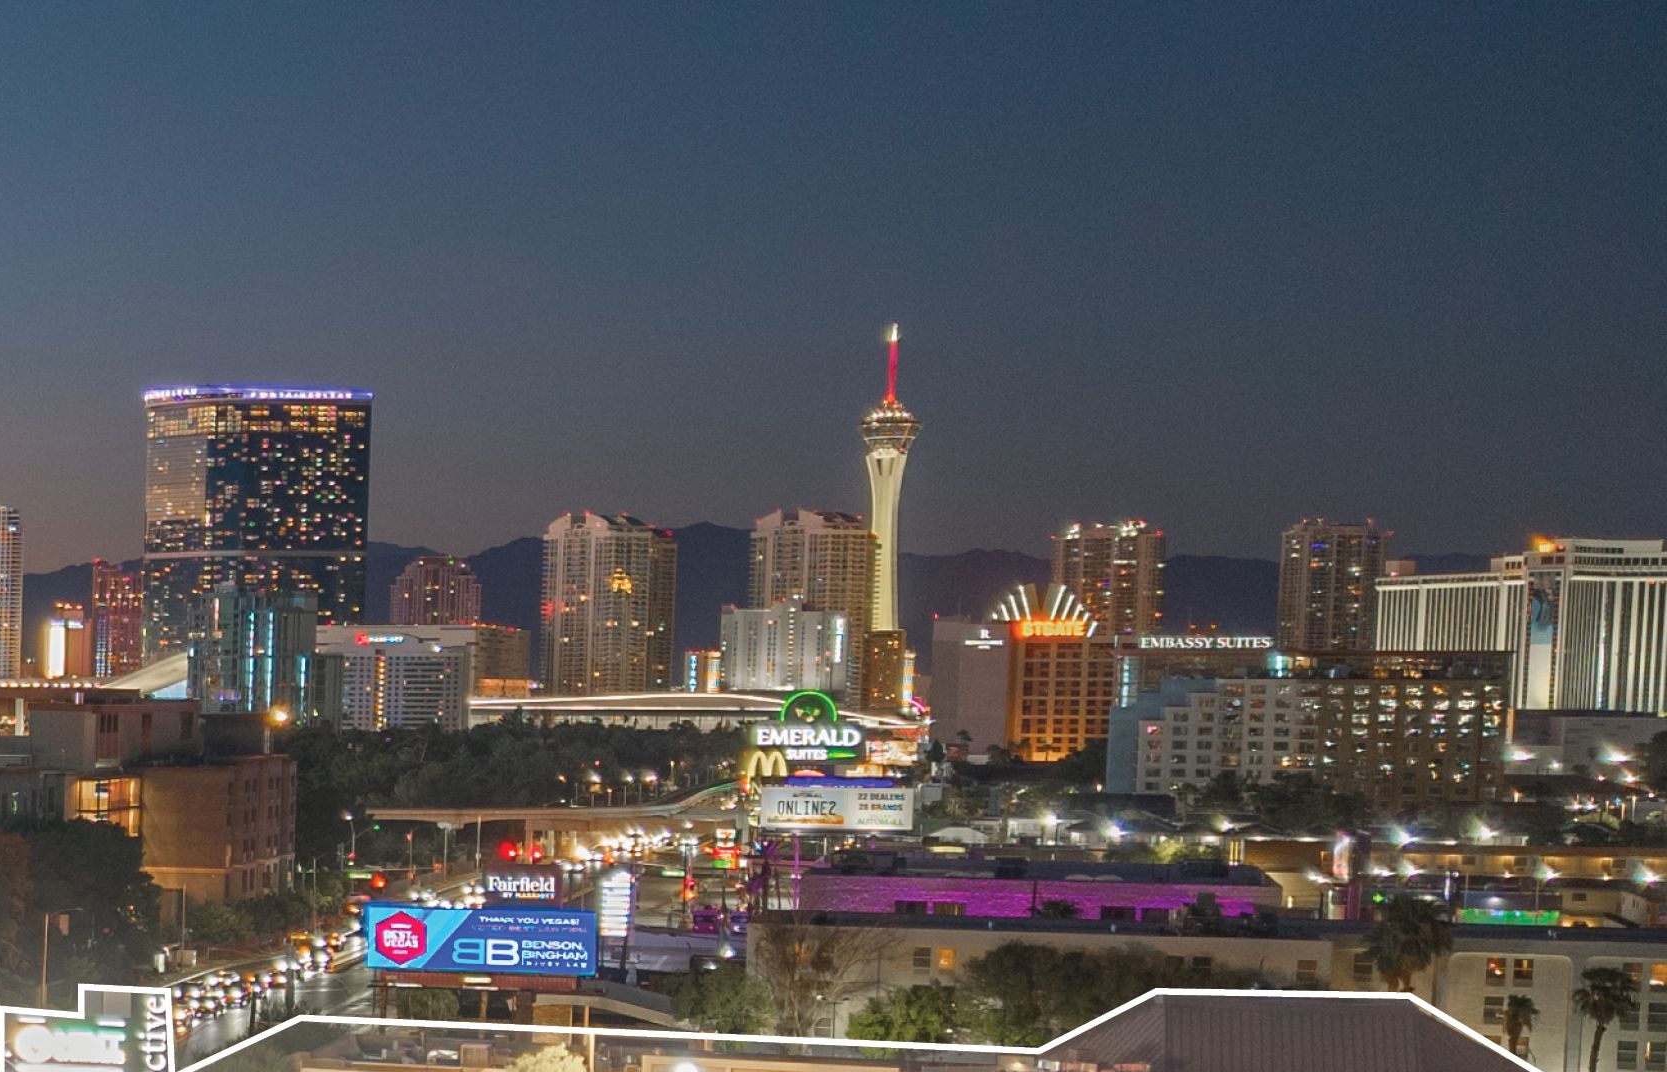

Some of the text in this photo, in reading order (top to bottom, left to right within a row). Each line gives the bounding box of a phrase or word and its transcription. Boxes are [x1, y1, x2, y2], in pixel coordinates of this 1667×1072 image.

[1141, 637, 1271, 649] EMBASSY SUITES
[756, 728, 860, 747] EMERALD
[785, 750, 828, 760] SUITES
[777, 800, 837, 816] ONLINE2
[488, 876, 555, 893] Fairfield
[479, 916, 514, 924] THANK
[516, 916, 539, 925] YOU
[522, 950, 588, 960] BINGHAM
